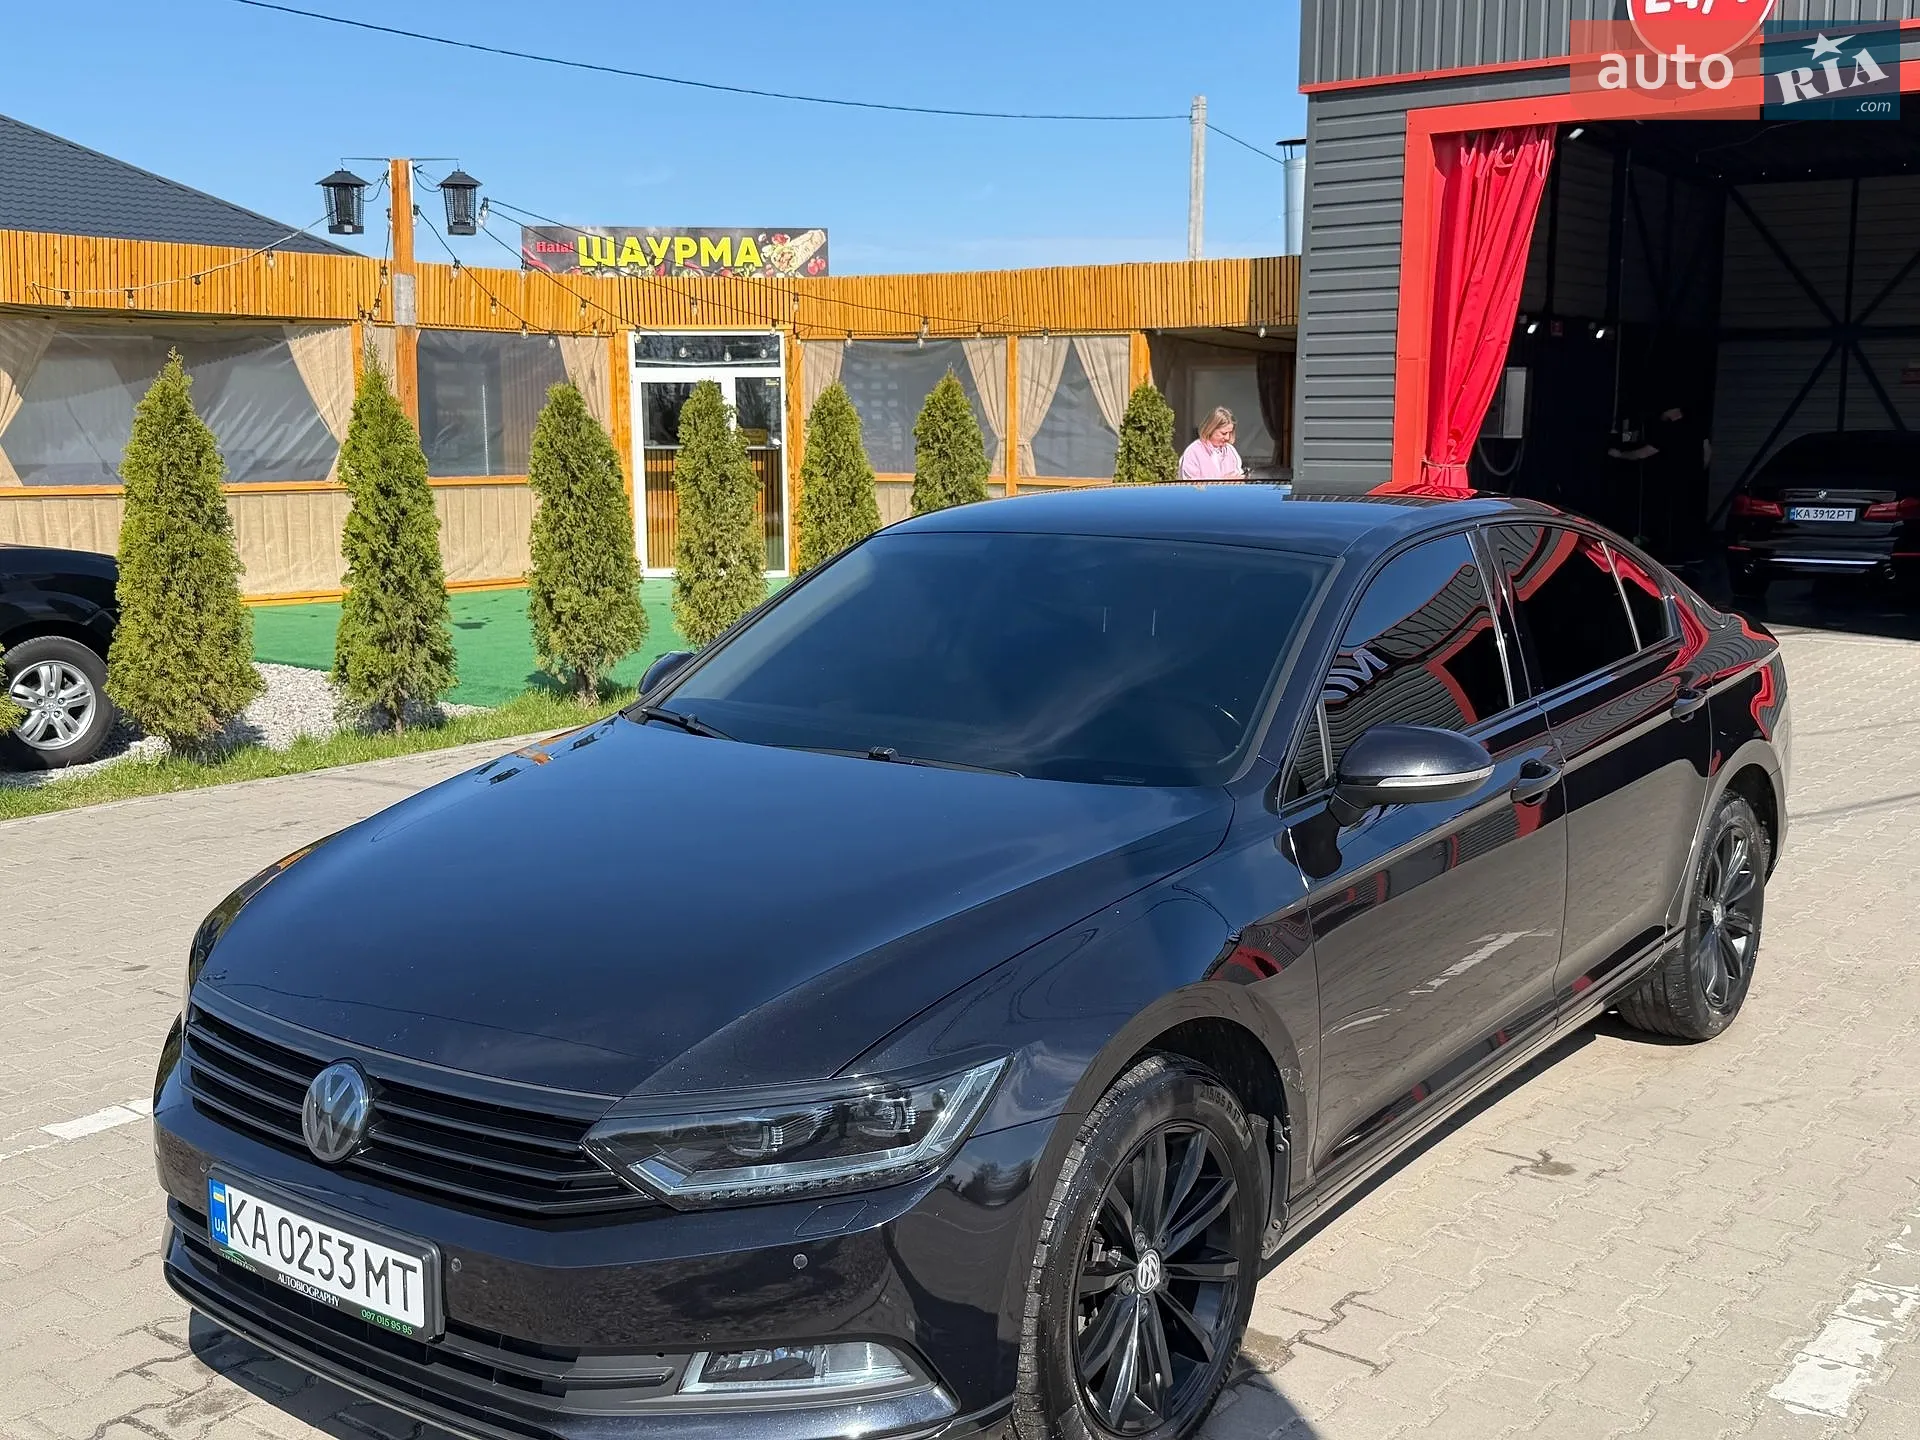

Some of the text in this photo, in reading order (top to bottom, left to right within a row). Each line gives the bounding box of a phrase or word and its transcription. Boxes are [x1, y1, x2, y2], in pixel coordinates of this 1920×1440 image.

[577, 235, 763, 268] ШАУРМА
[1795, 509, 1810, 519] KA
[1812, 509, 1836, 519] 3912
[1836, 510, 1853, 520] PT
[214, 1216, 227, 1236] UA
[227, 1192, 418, 1312] KA 0253 MT
[277, 1273, 340, 1307] AUTOBIOGRAPHY
[361, 1309, 375, 1322] 097
[390, 1319, 402, 1332] 95
[402, 1324, 413, 1336] 95
